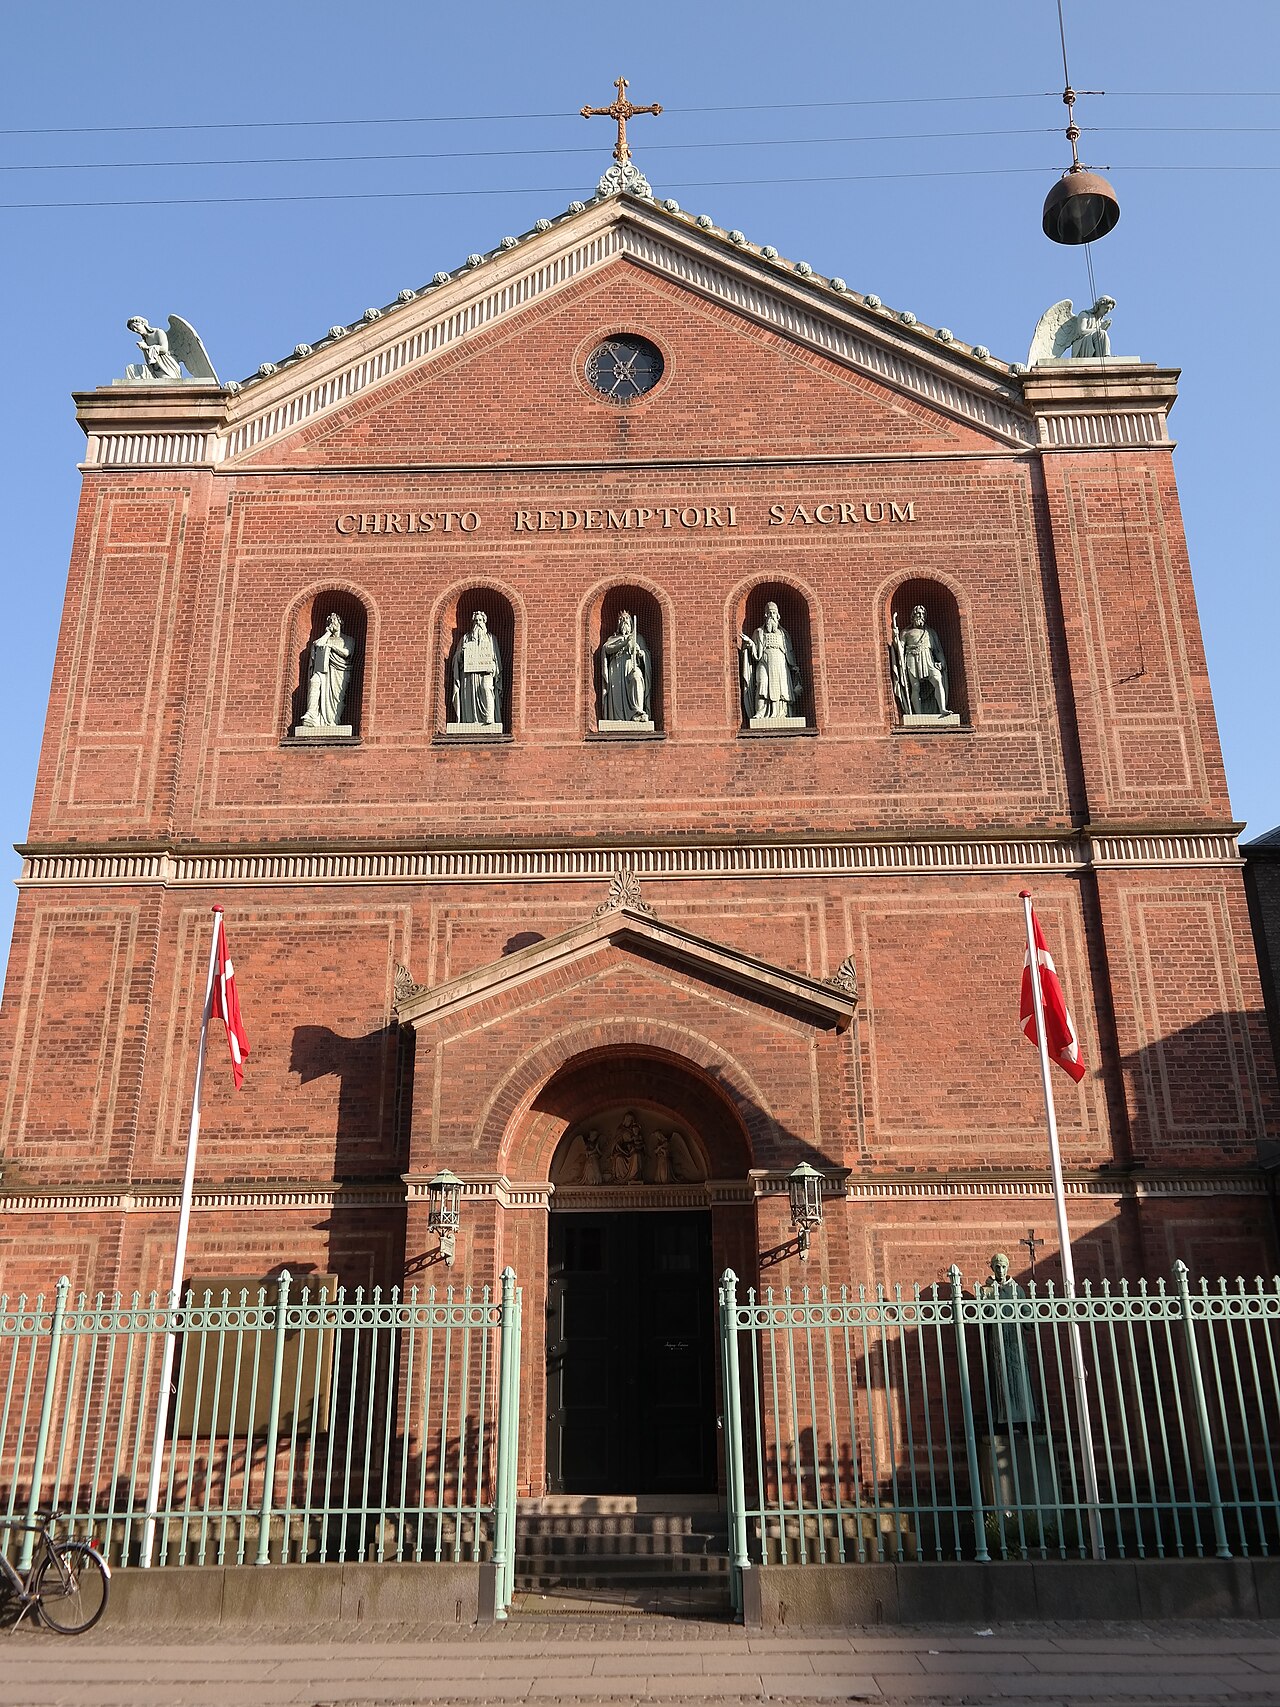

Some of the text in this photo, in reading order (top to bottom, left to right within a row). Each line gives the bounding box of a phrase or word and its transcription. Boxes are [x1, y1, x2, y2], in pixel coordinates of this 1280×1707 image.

[336, 501, 917, 534] CHRISTO REDEMPTORI SACRUM
